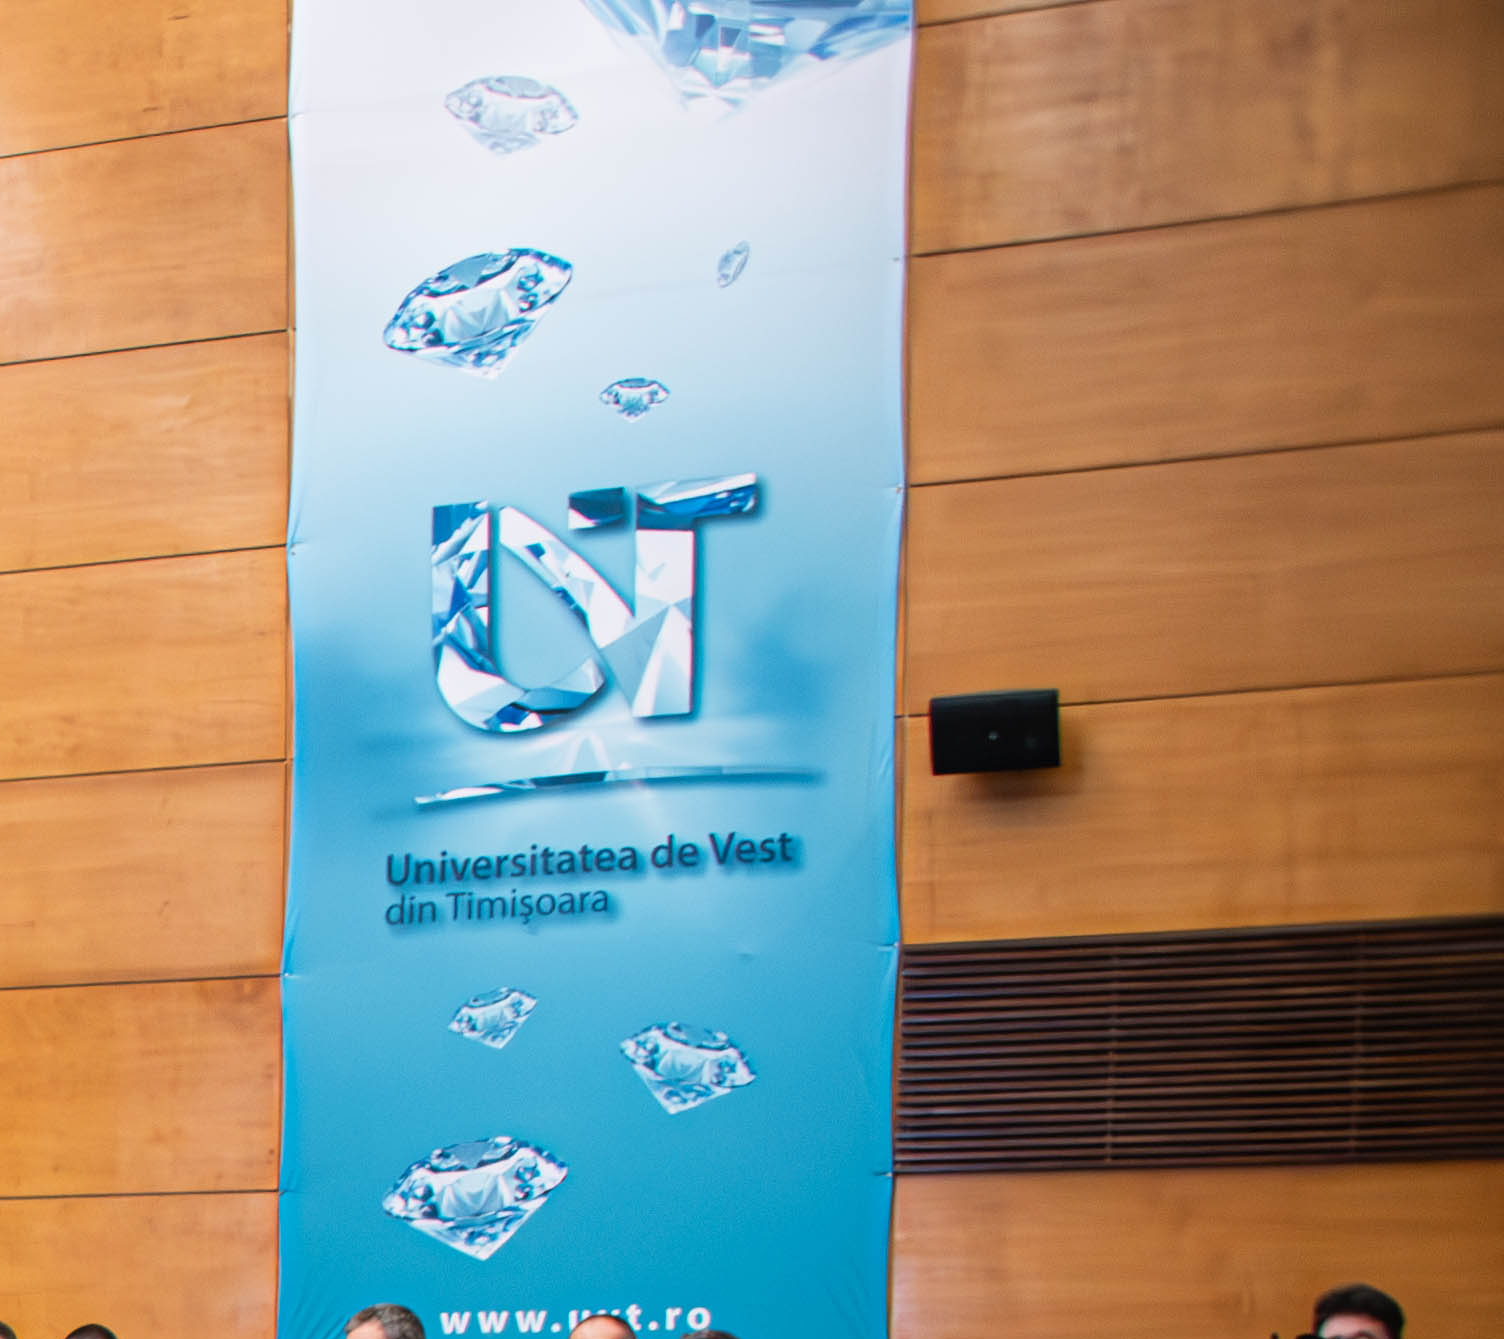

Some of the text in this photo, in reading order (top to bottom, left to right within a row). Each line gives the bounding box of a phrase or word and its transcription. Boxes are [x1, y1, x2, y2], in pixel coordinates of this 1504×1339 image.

[386, 832, 794, 887] Universitatea de Vest
[385, 894, 437, 926] din
